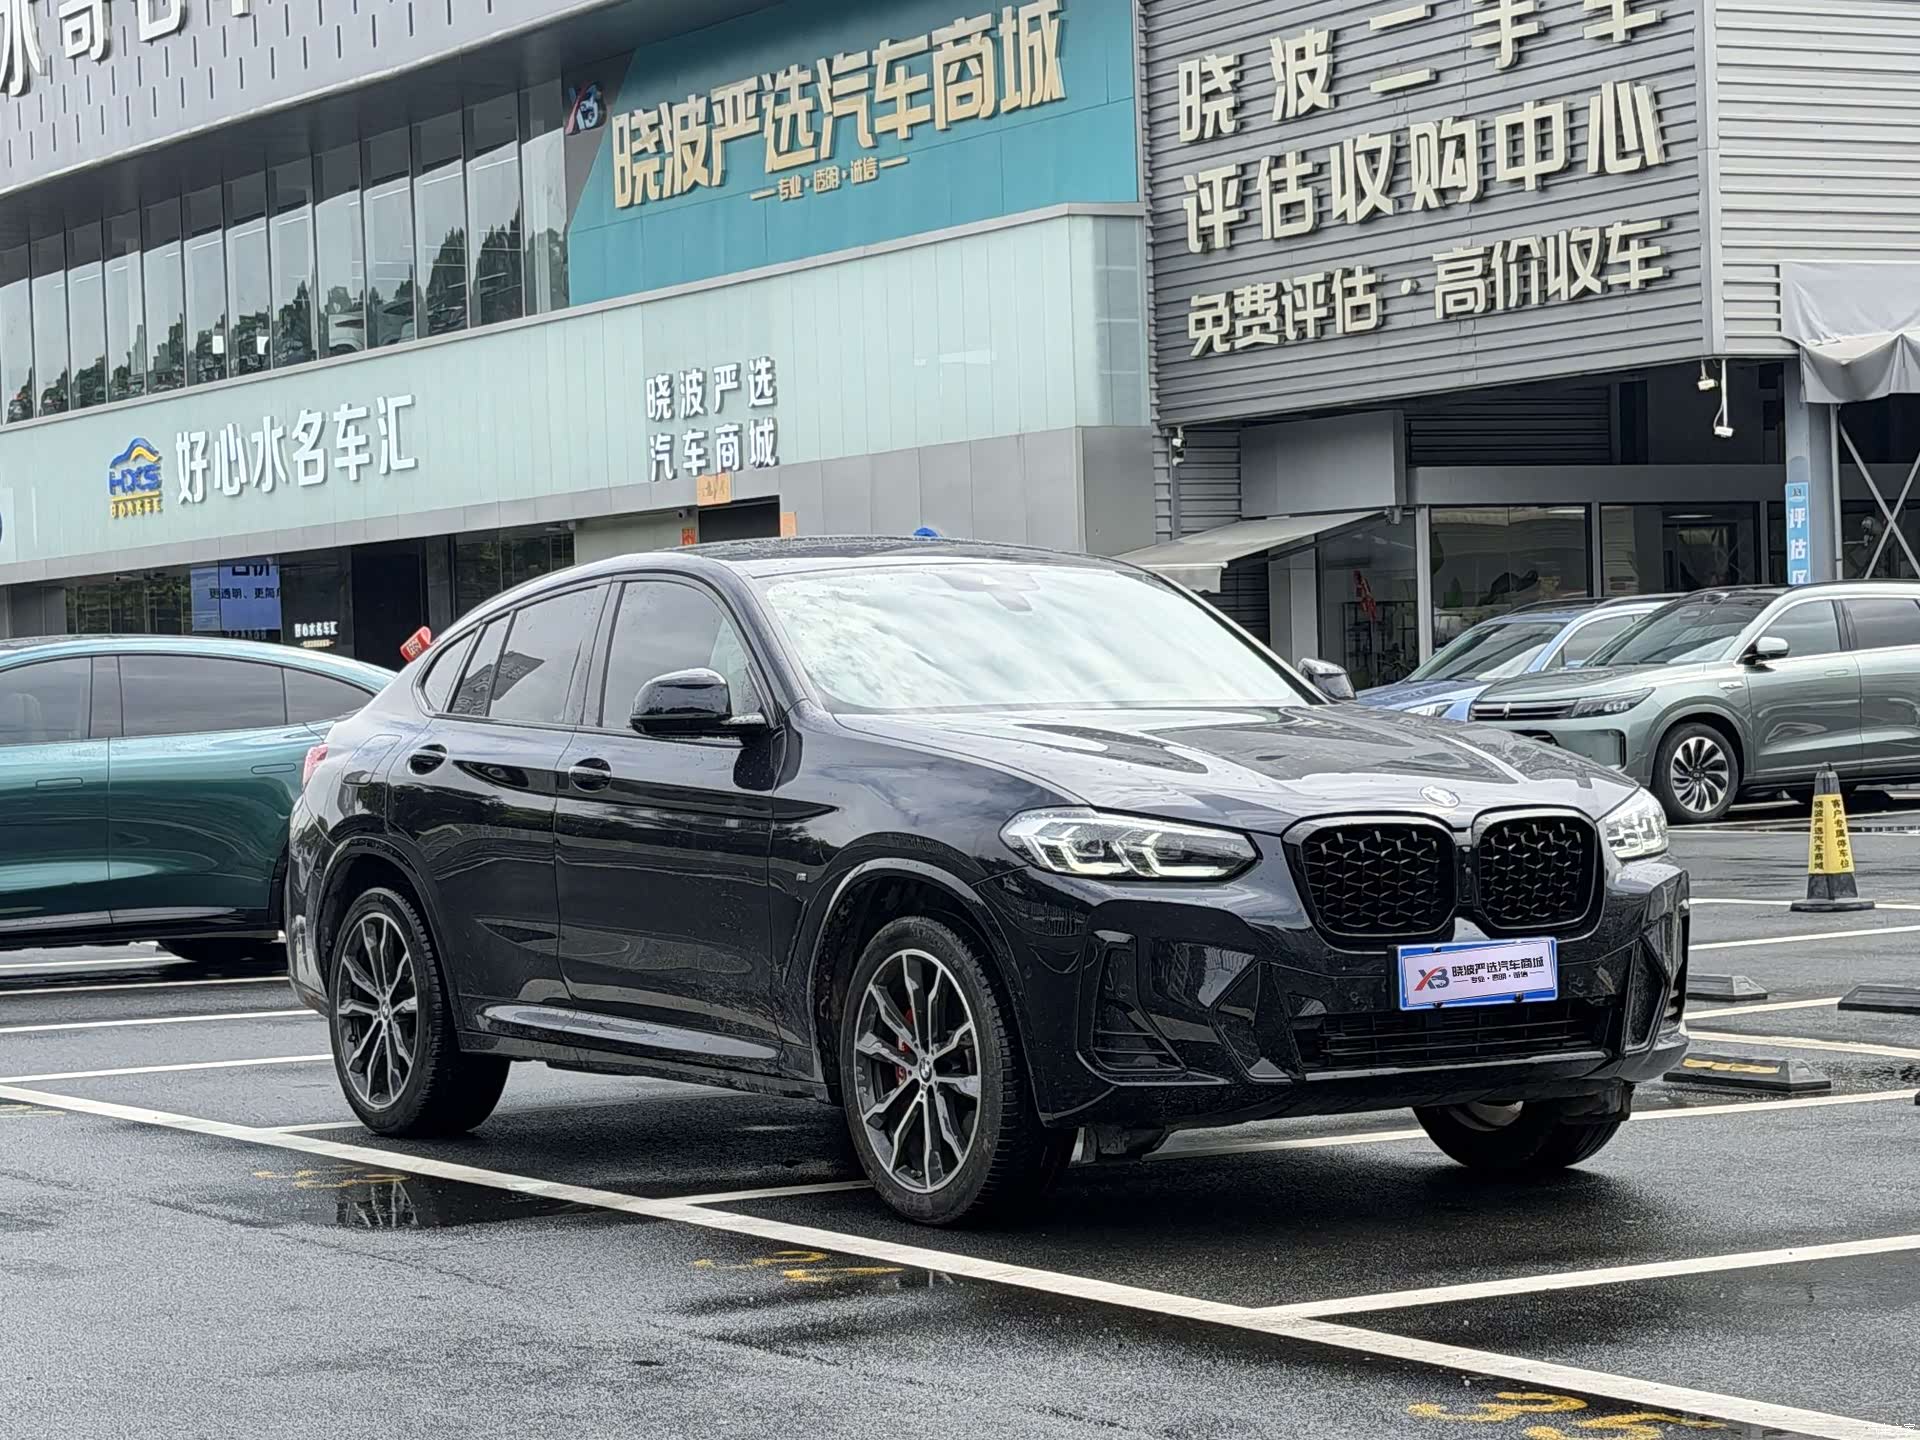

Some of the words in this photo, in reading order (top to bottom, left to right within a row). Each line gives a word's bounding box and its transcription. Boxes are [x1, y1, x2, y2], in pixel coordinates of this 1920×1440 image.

[612, 0, 1066, 208] 晓波严选汽车商城
[1183, 81, 1667, 253] 评估收购中心
[646, 357, 776, 420] 晓波严选
[177, 395, 417, 503] 好心水名车汇
[648, 418, 779, 481] 汽车商城
[1789, 507, 1807, 584] 评估区
[1452, 957, 1544, 977] 晓波严选汽车商城
